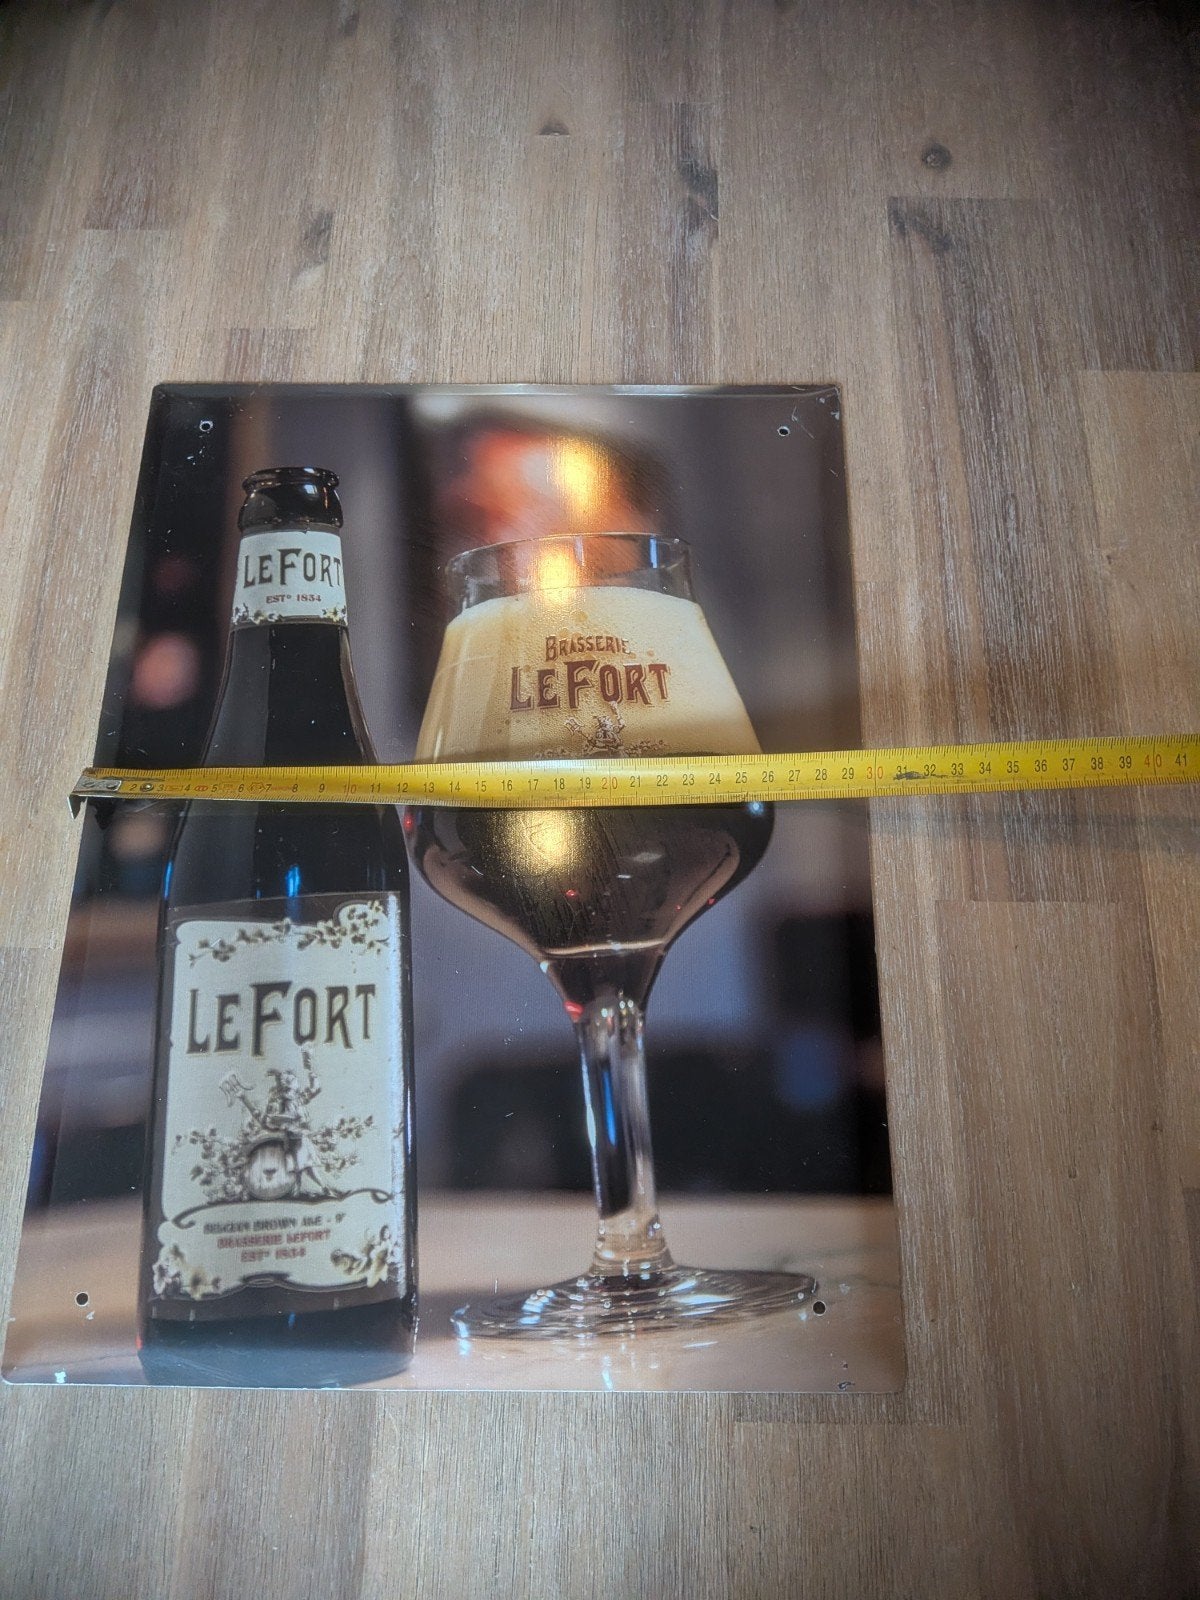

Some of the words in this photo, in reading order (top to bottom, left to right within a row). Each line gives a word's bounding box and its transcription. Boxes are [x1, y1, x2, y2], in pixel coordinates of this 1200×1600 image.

[296, 594, 322, 603] 1834
[510, 660, 671, 712] LEFORT
[342, 784, 356, 794] 10
[370, 783, 381, 793] 11
[397, 782, 408, 793] 12
[423, 782, 435, 793] 13
[449, 781, 461, 793] 14
[475, 781, 487, 793] 15
[501, 780, 513, 791] 16
[528, 779, 539, 791] 17
[554, 778, 565, 790] 18
[580, 777, 591, 789] 19
[601, 777, 618, 790] 20
[630, 775, 641, 788] 21
[656, 774, 669, 787] 22
[682, 773, 695, 786] 23
[709, 772, 721, 785] 24
[735, 771, 748, 784] 25
[762, 770, 775, 783] 26
[788, 769, 800, 782] 27
[815, 768, 828, 781] 28
[842, 767, 855, 780] 29
[866, 767, 884, 780] 30
[924, 764, 936, 776] 32
[951, 763, 964, 776] 33
[979, 762, 992, 774] 34
[1006, 761, 1019, 774] 35
[1034, 759, 1048, 772] 36
[1062, 758, 1075, 771] 37
[1091, 757, 1103, 770] 38
[1119, 756, 1132, 769] 39
[1144, 755, 1162, 768] 40
[1175, 753, 1187, 766] 41
[186, 981, 376, 1057] LEFORT
